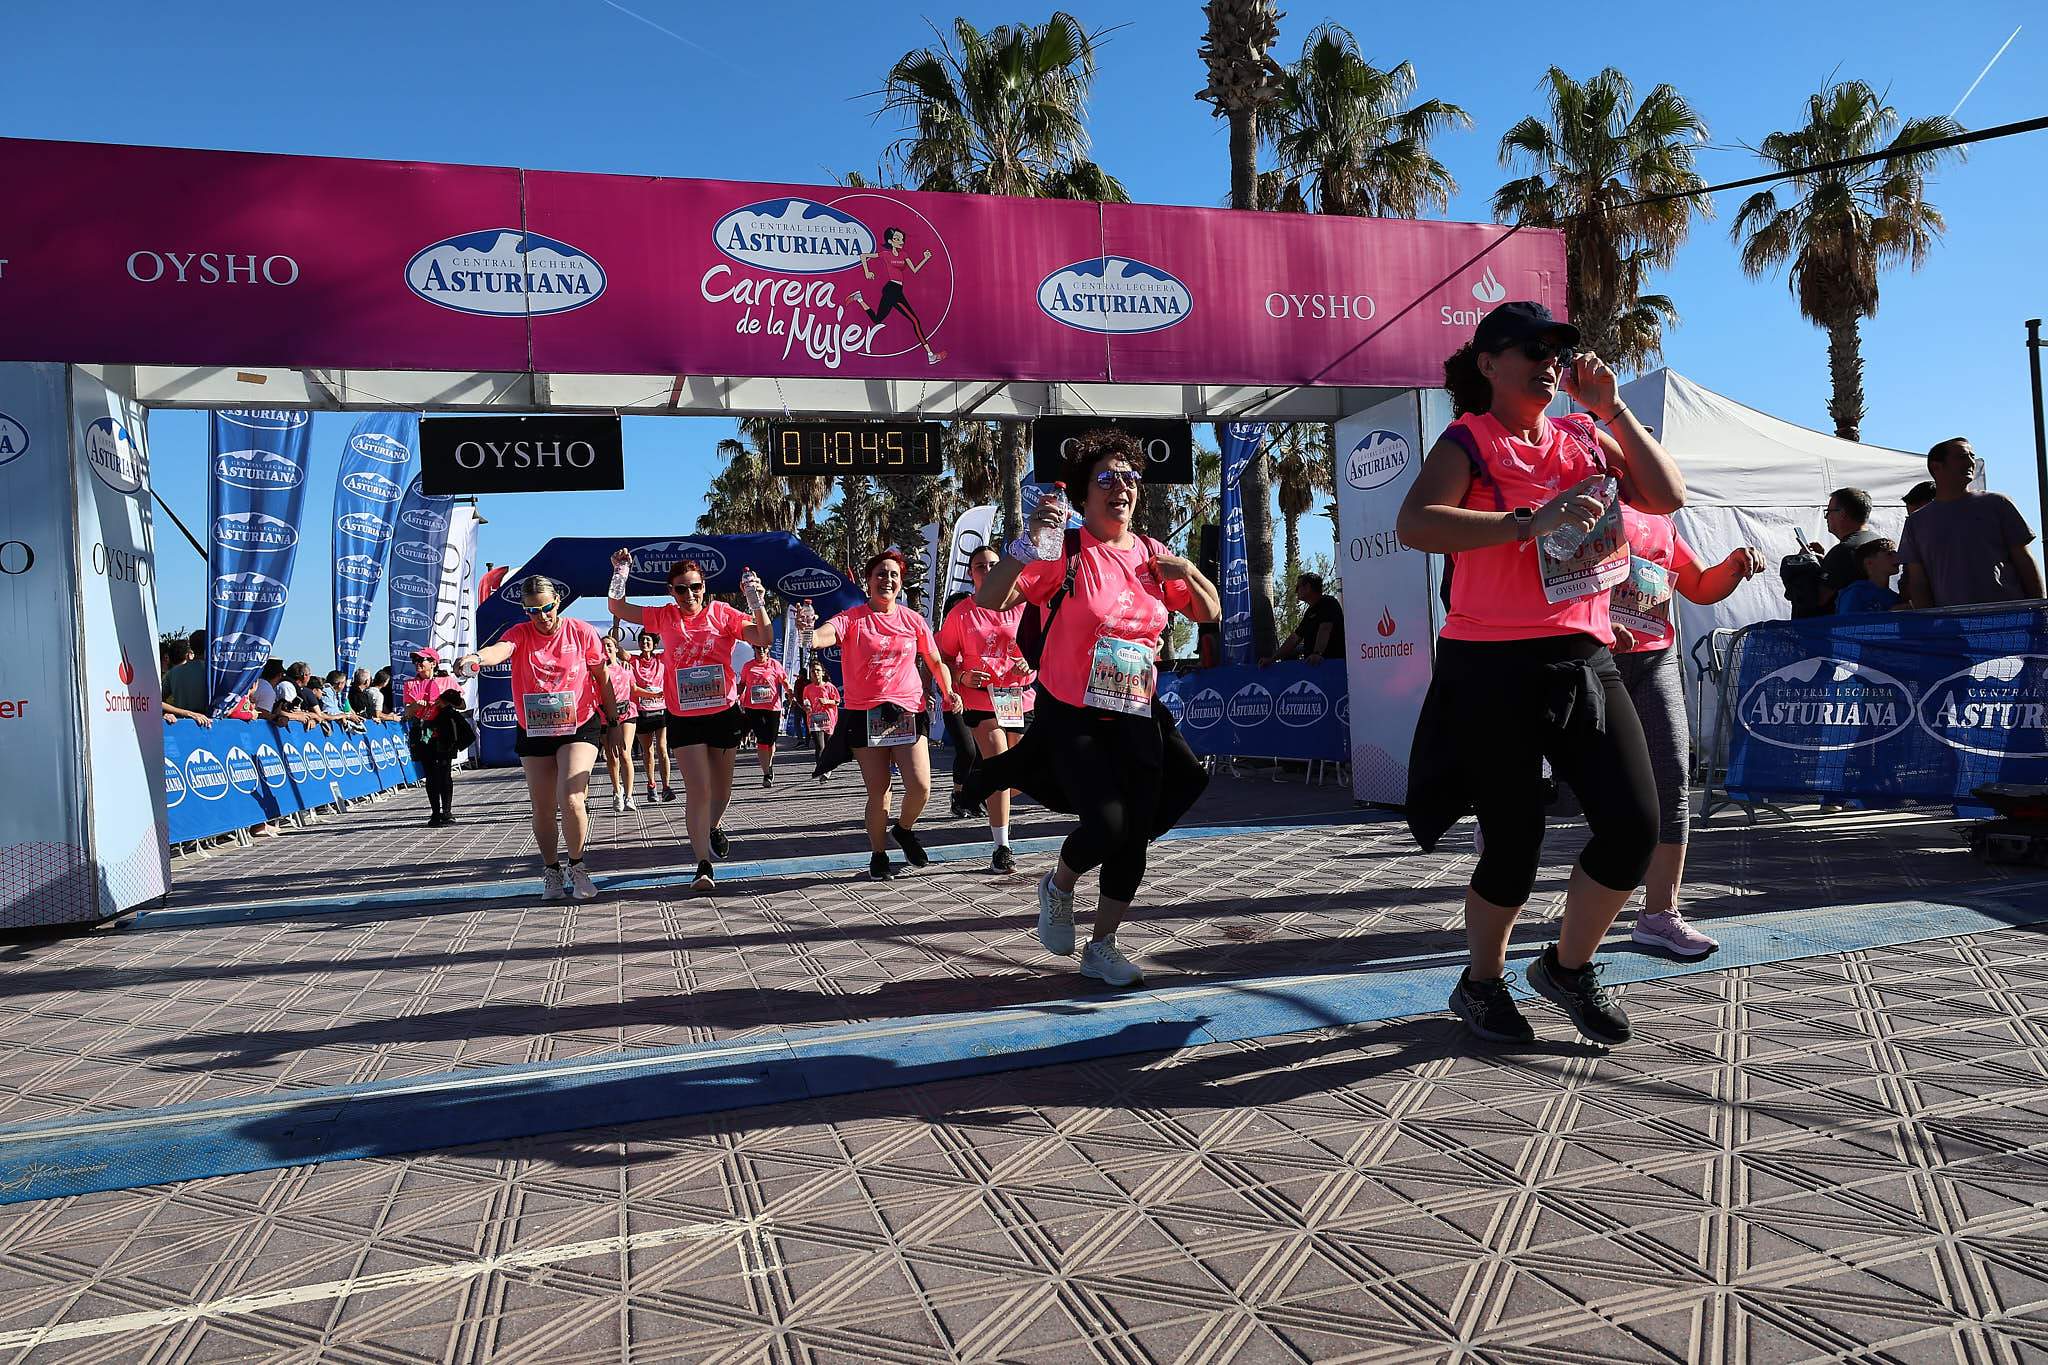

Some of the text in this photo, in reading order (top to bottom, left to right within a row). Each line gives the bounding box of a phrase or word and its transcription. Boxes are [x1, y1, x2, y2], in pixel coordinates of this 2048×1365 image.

[751, 221, 858, 235] CENTRAL LECHERA
[726, 222, 863, 256] ASTURIANA
[126, 250, 300, 286] OYSHO
[452, 257, 516, 268] CENTRAL
[422, 258, 593, 295] ASTURIANA
[700, 264, 836, 309] Carrera
[1073, 282, 1176, 292] CENTRAL LECHERA
[1050, 282, 1182, 314] ASTURIANA
[1264, 293, 1377, 321] OYSHO
[736, 307, 785, 335] de la
[782, 305, 886, 369] Mujer
[355, 440, 406, 460] ASTURIANA
[454, 440, 596, 469] OYSHO
[217, 459, 297, 483] ASTURIANA
[1349, 451, 1405, 481] ASTURIANA
[347, 477, 398, 498] ASTURIANA
[342, 518, 390, 538] ASTURIANA
[405, 513, 444, 529] ASTURIANA
[216, 526, 291, 545] ASTURIANA
[398, 545, 438, 562] ASTURIANA
[630, 554, 719, 573] ASTUNA
[92, 542, 149, 587] OYSHO
[393, 580, 433, 595] ASTURIANA
[783, 579, 838, 591] ASTURIANA
[1548, 574, 1574, 585] CARRERA
[1555, 582, 1587, 596] OYSHO
[390, 613, 429, 627] ASTURIANA
[1361, 640, 1414, 660] Santander
[105, 689, 151, 712] Santander
[1777, 687, 1893, 697] CENTRAL LECHERA
[1967, 688, 2040, 698] CENTRAL
[1189, 705, 1221, 720] ASTURIANA
[1230, 701, 1269, 718] ASTURIANA
[1279, 699, 1322, 716] ASTURIANA
[1749, 690, 1898, 726] ASTURIANA
[189, 768, 227, 789] ASTURIANA
